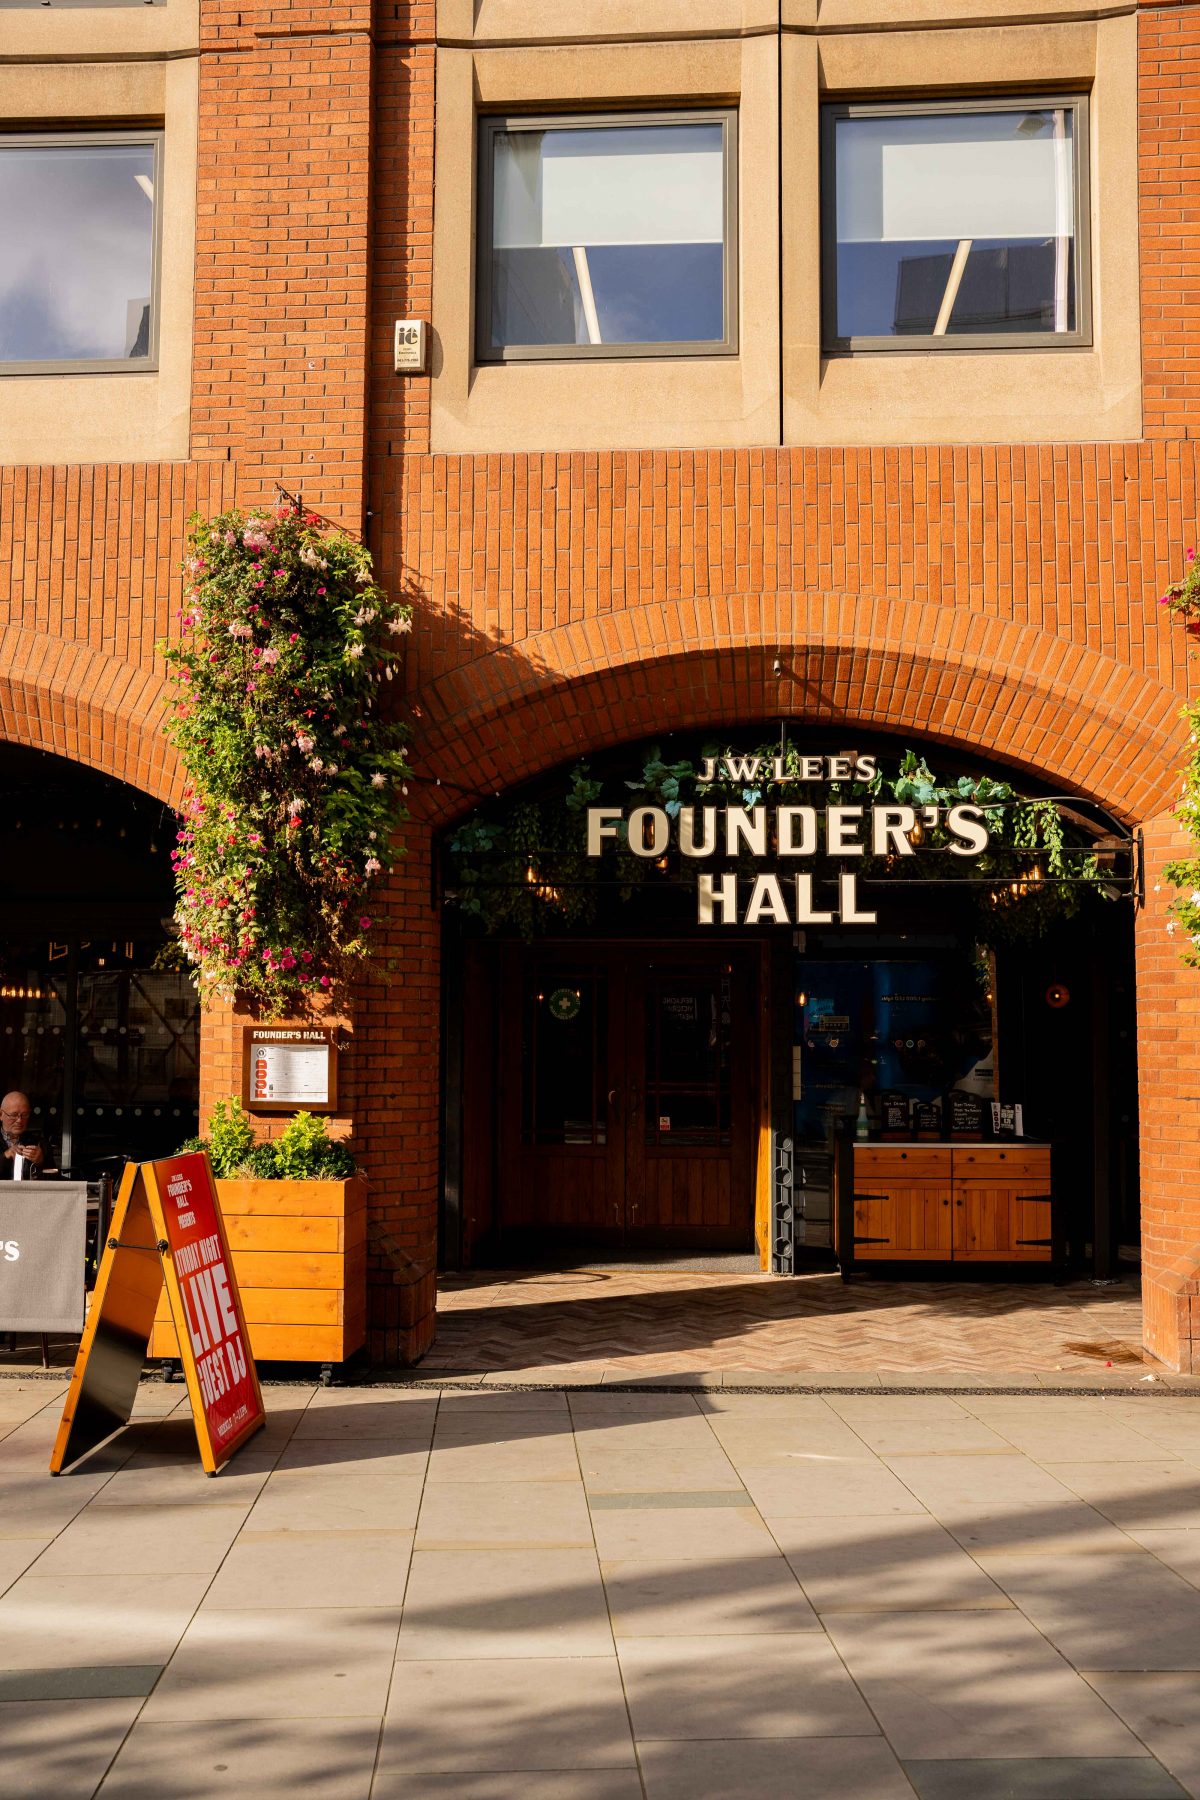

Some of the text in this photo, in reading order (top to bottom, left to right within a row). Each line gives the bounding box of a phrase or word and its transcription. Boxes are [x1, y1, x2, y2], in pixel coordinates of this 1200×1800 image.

[586, 804, 990, 858] FOUNDER'S
[697, 873, 878, 926] HALL
[253, 1030, 326, 1040] FOUNDER'S HALL
[255, 1059, 268, 1098] FOOD
[199, 1234, 222, 1264] NIGHT
[180, 1262, 239, 1358] LIVE
[226, 1335, 247, 1385] DJ
